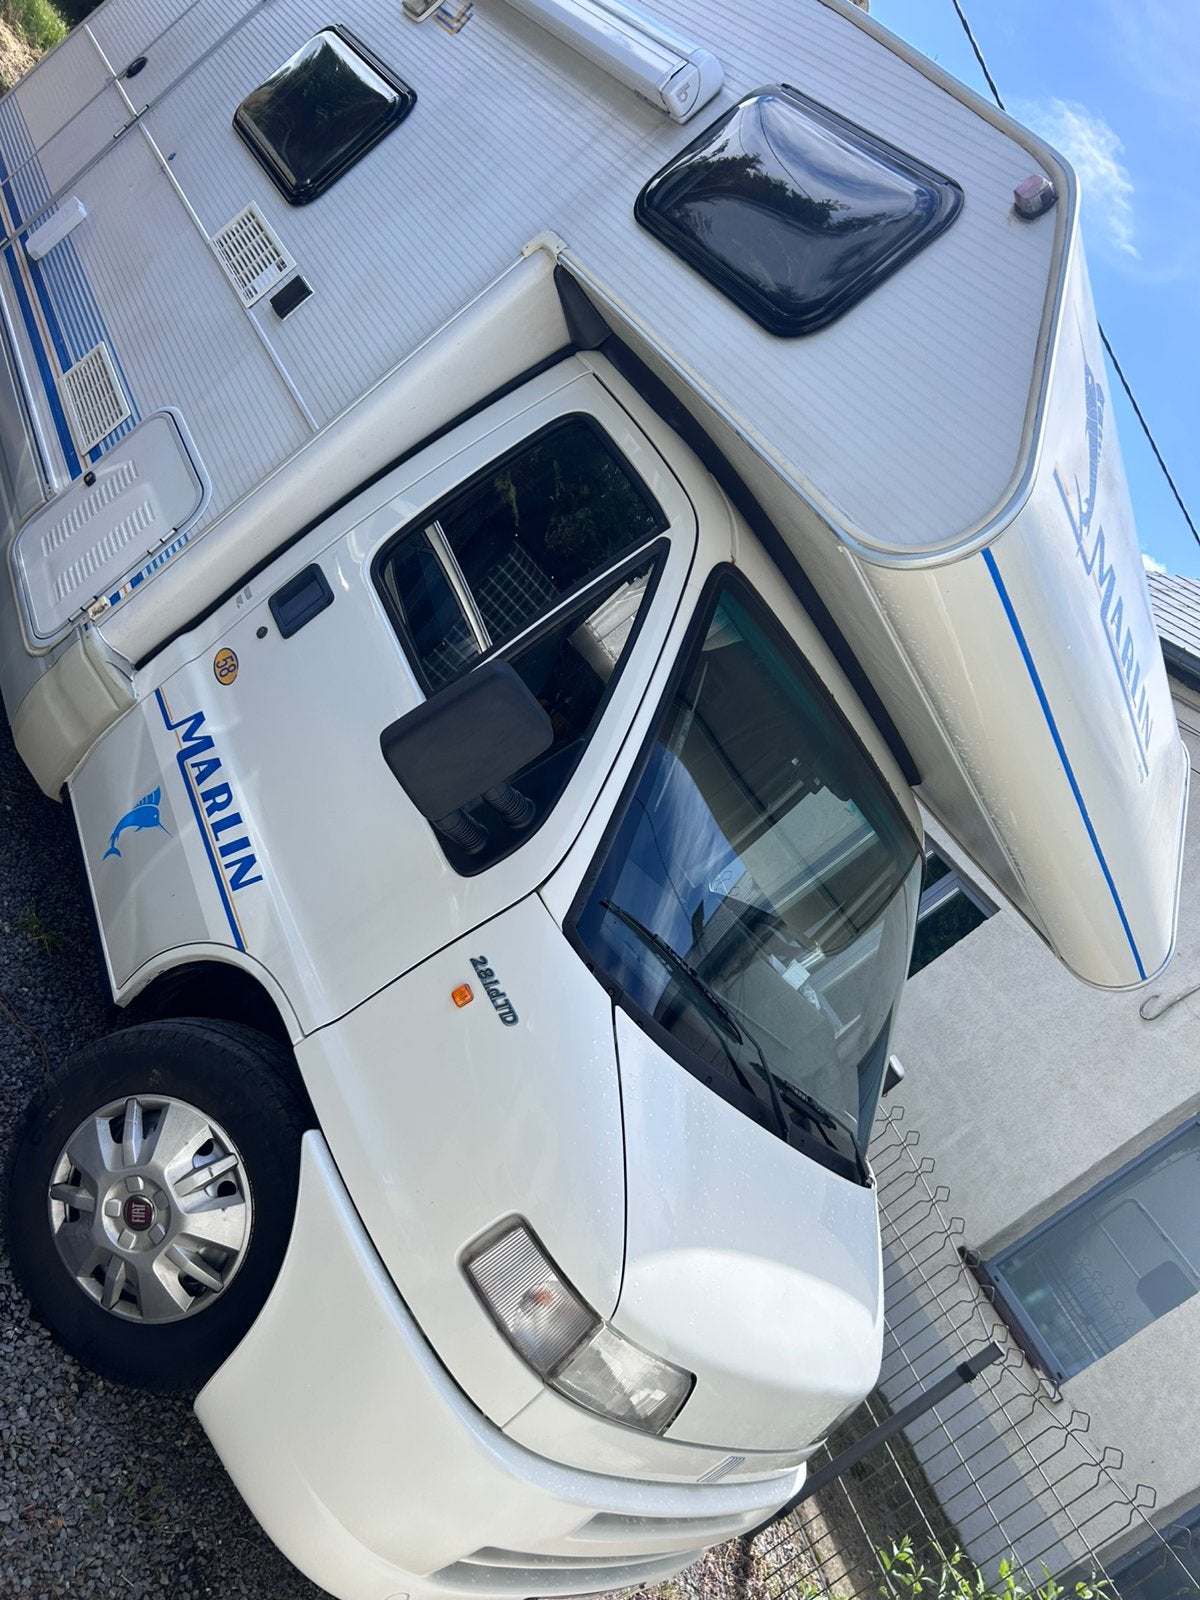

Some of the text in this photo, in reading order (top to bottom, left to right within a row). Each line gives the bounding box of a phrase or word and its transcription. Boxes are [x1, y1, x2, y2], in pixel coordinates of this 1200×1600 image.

[216, 655, 237, 678] 58
[1087, 525, 1153, 752] MARLIN
[166, 710, 264, 892] MARLIN
[131, 1202, 146, 1223] FIAT
